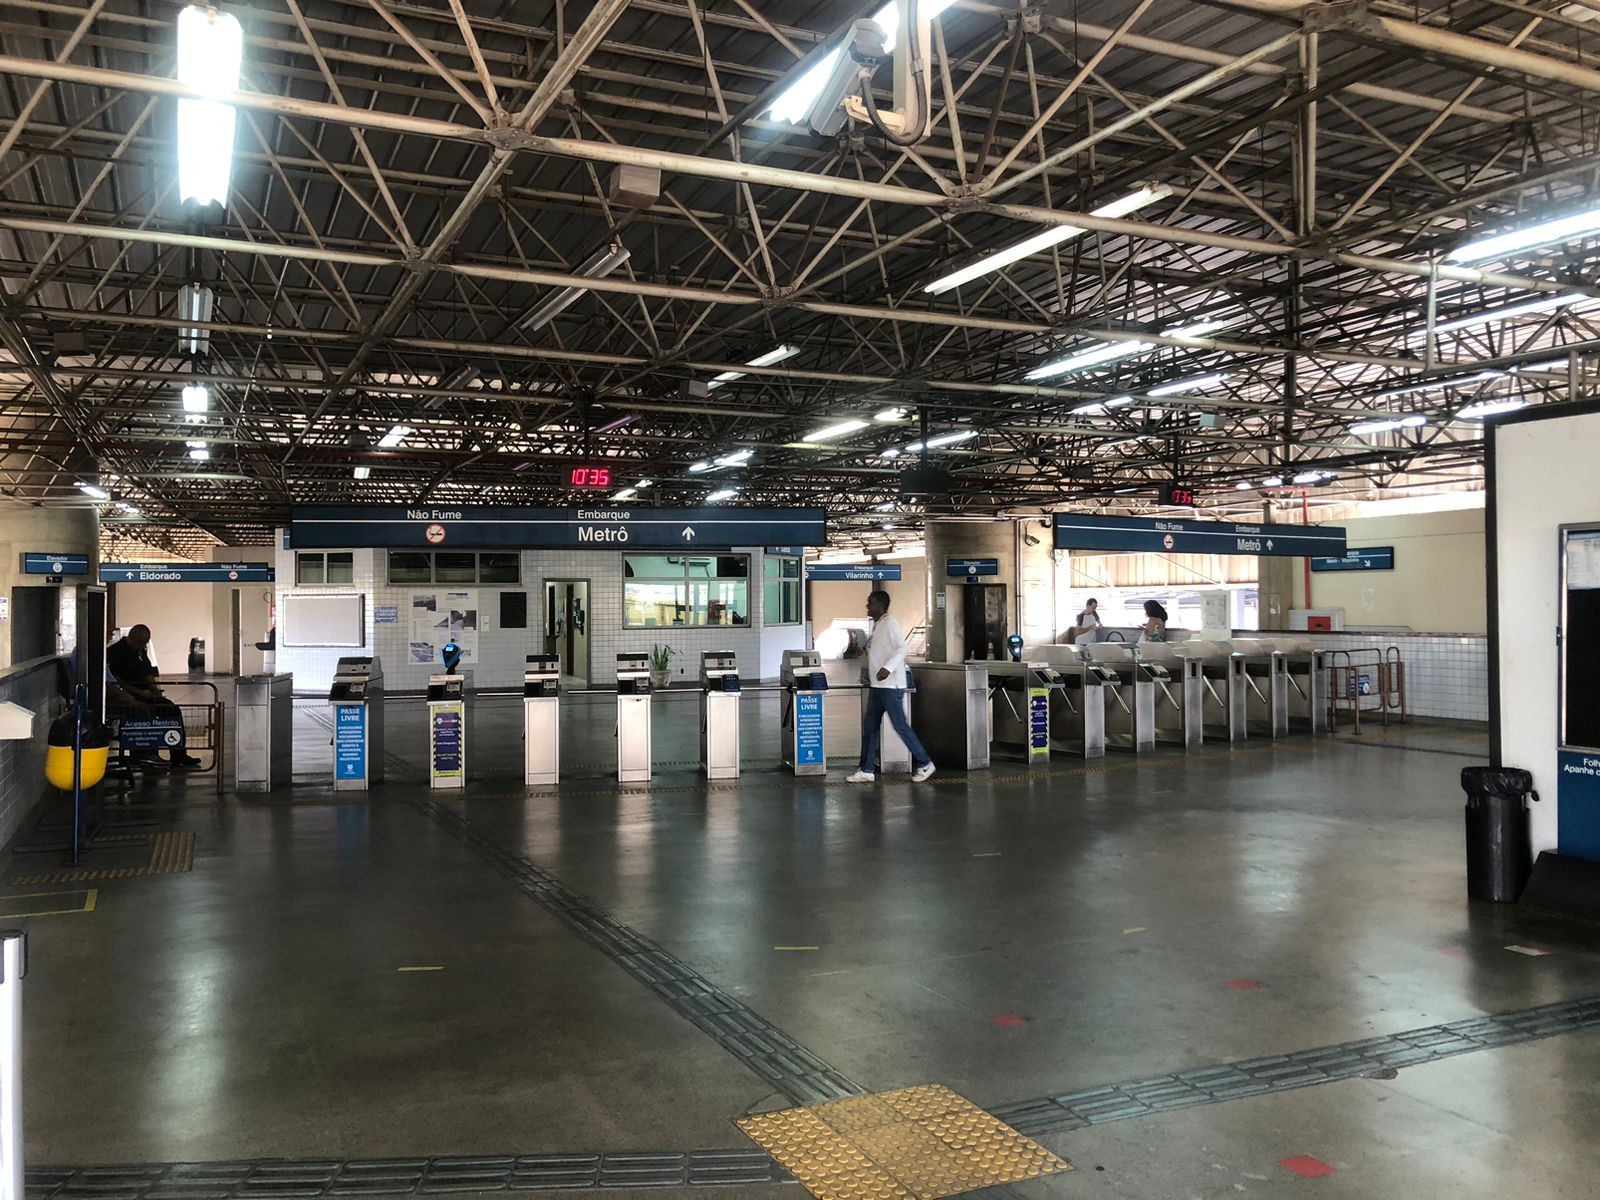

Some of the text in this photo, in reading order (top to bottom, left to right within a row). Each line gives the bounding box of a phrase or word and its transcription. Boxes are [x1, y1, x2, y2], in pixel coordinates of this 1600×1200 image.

[407, 510, 462, 519] Não Fume
[577, 509, 630, 521] Embarque
[1167, 522, 1183, 531] Fume
[1235, 525, 1260, 534] Embarque
[578, 526, 628, 542] Metrô
[1237, 538, 1261, 551] Metrô
[139, 571, 182, 580] Eldorado
[152, 719, 179, 727] Restrito
[1564, 764, 1594, 776] Apanhe
